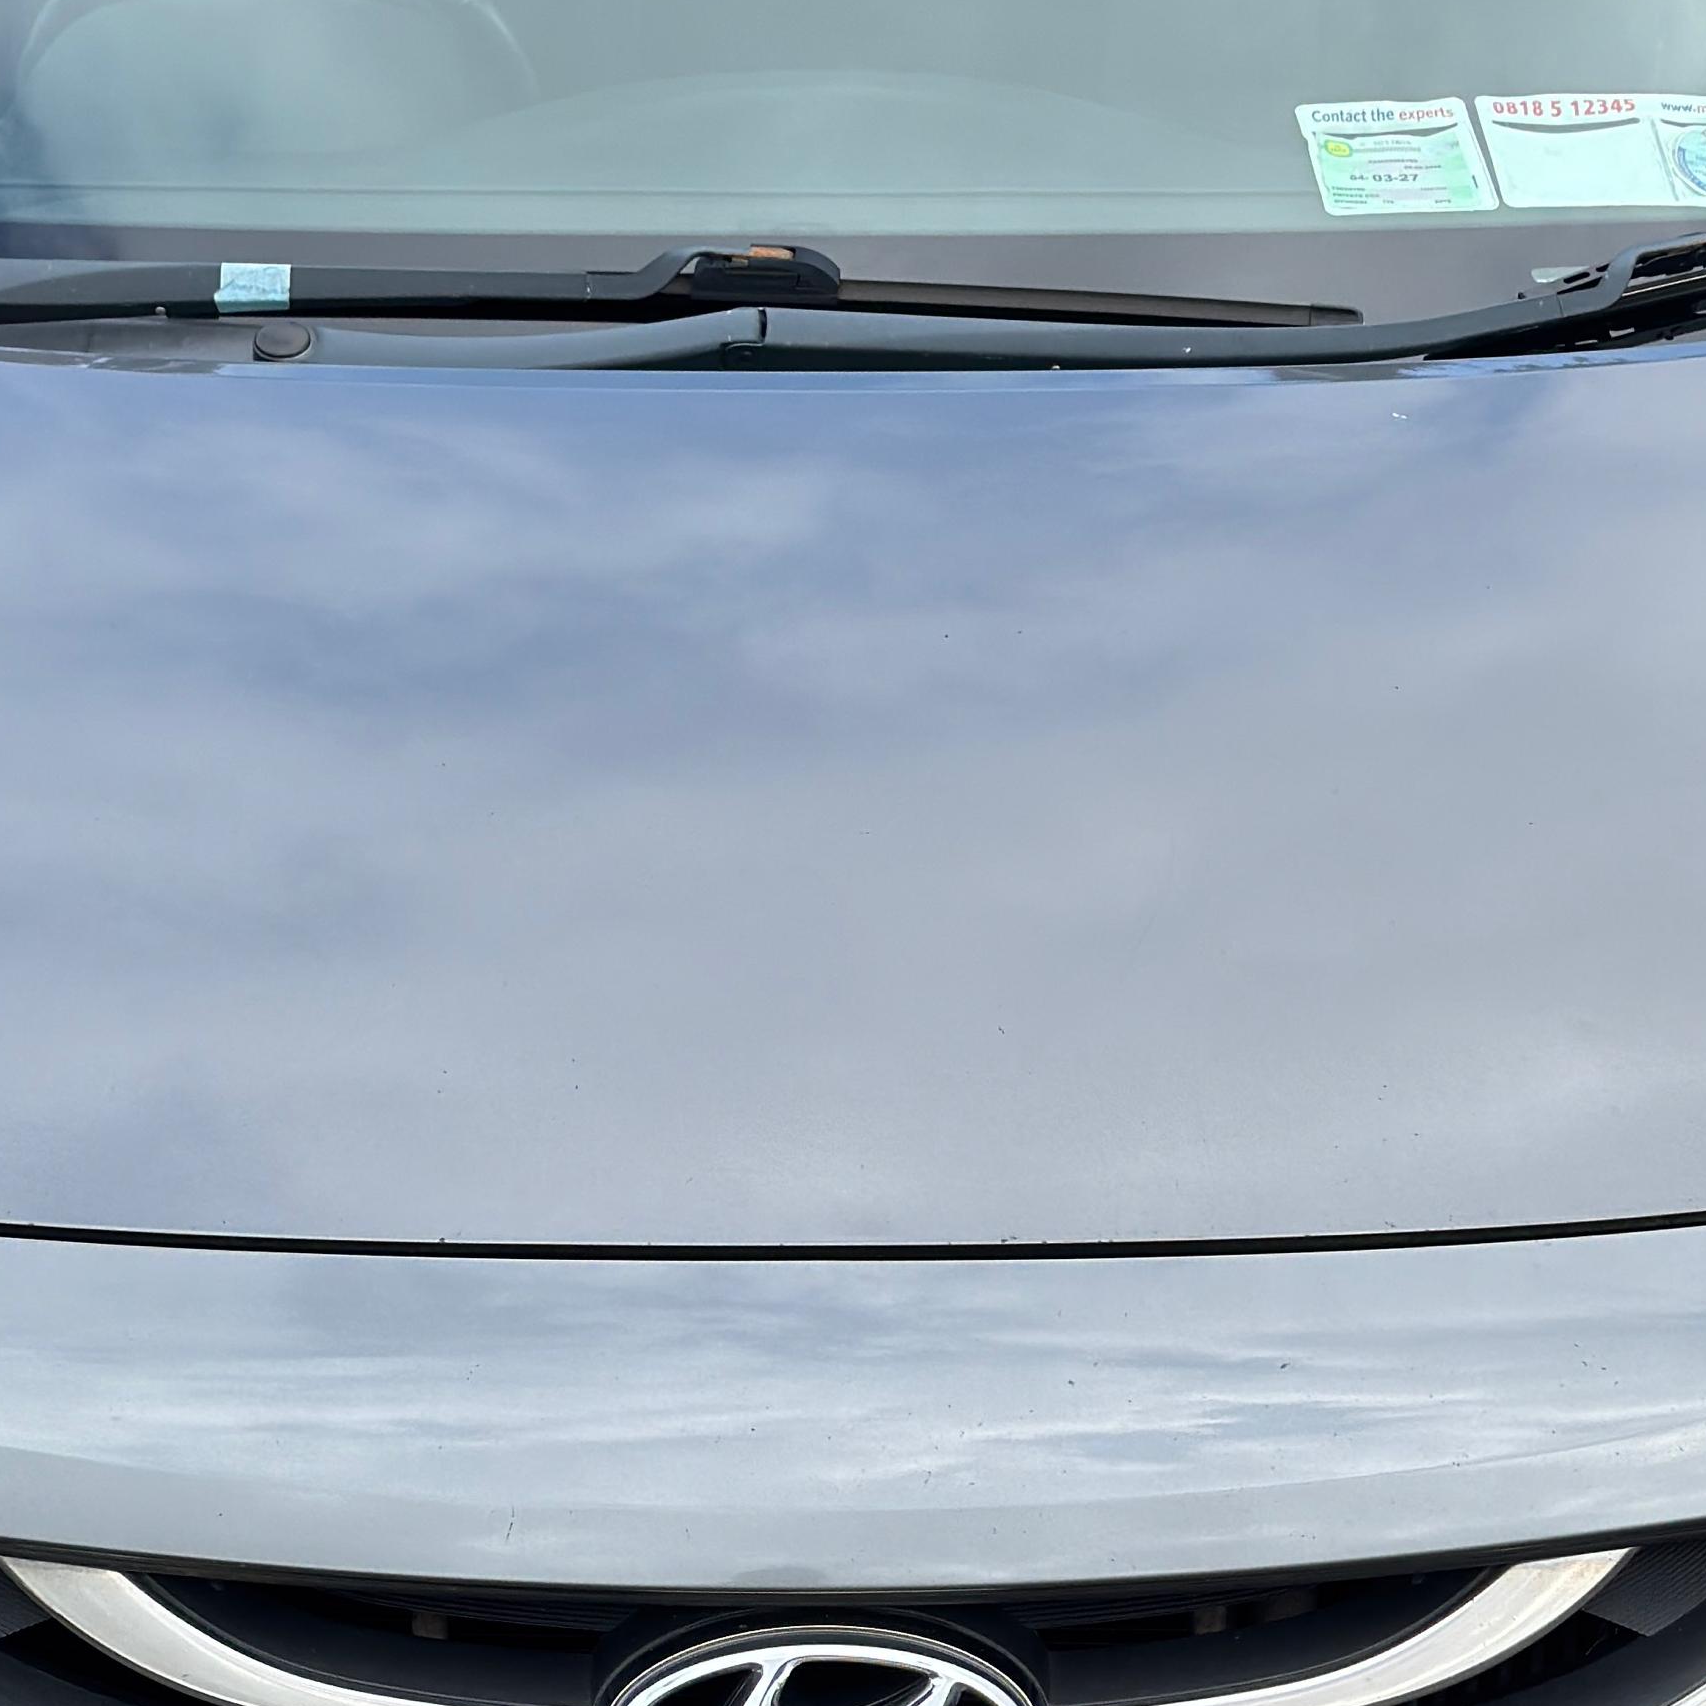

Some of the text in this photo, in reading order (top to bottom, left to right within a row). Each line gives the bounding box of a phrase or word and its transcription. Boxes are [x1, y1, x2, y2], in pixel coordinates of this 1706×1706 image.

[1311, 106, 1455, 123] Contact the experts
[1492, 98, 1636, 118] 0818 5 12345
